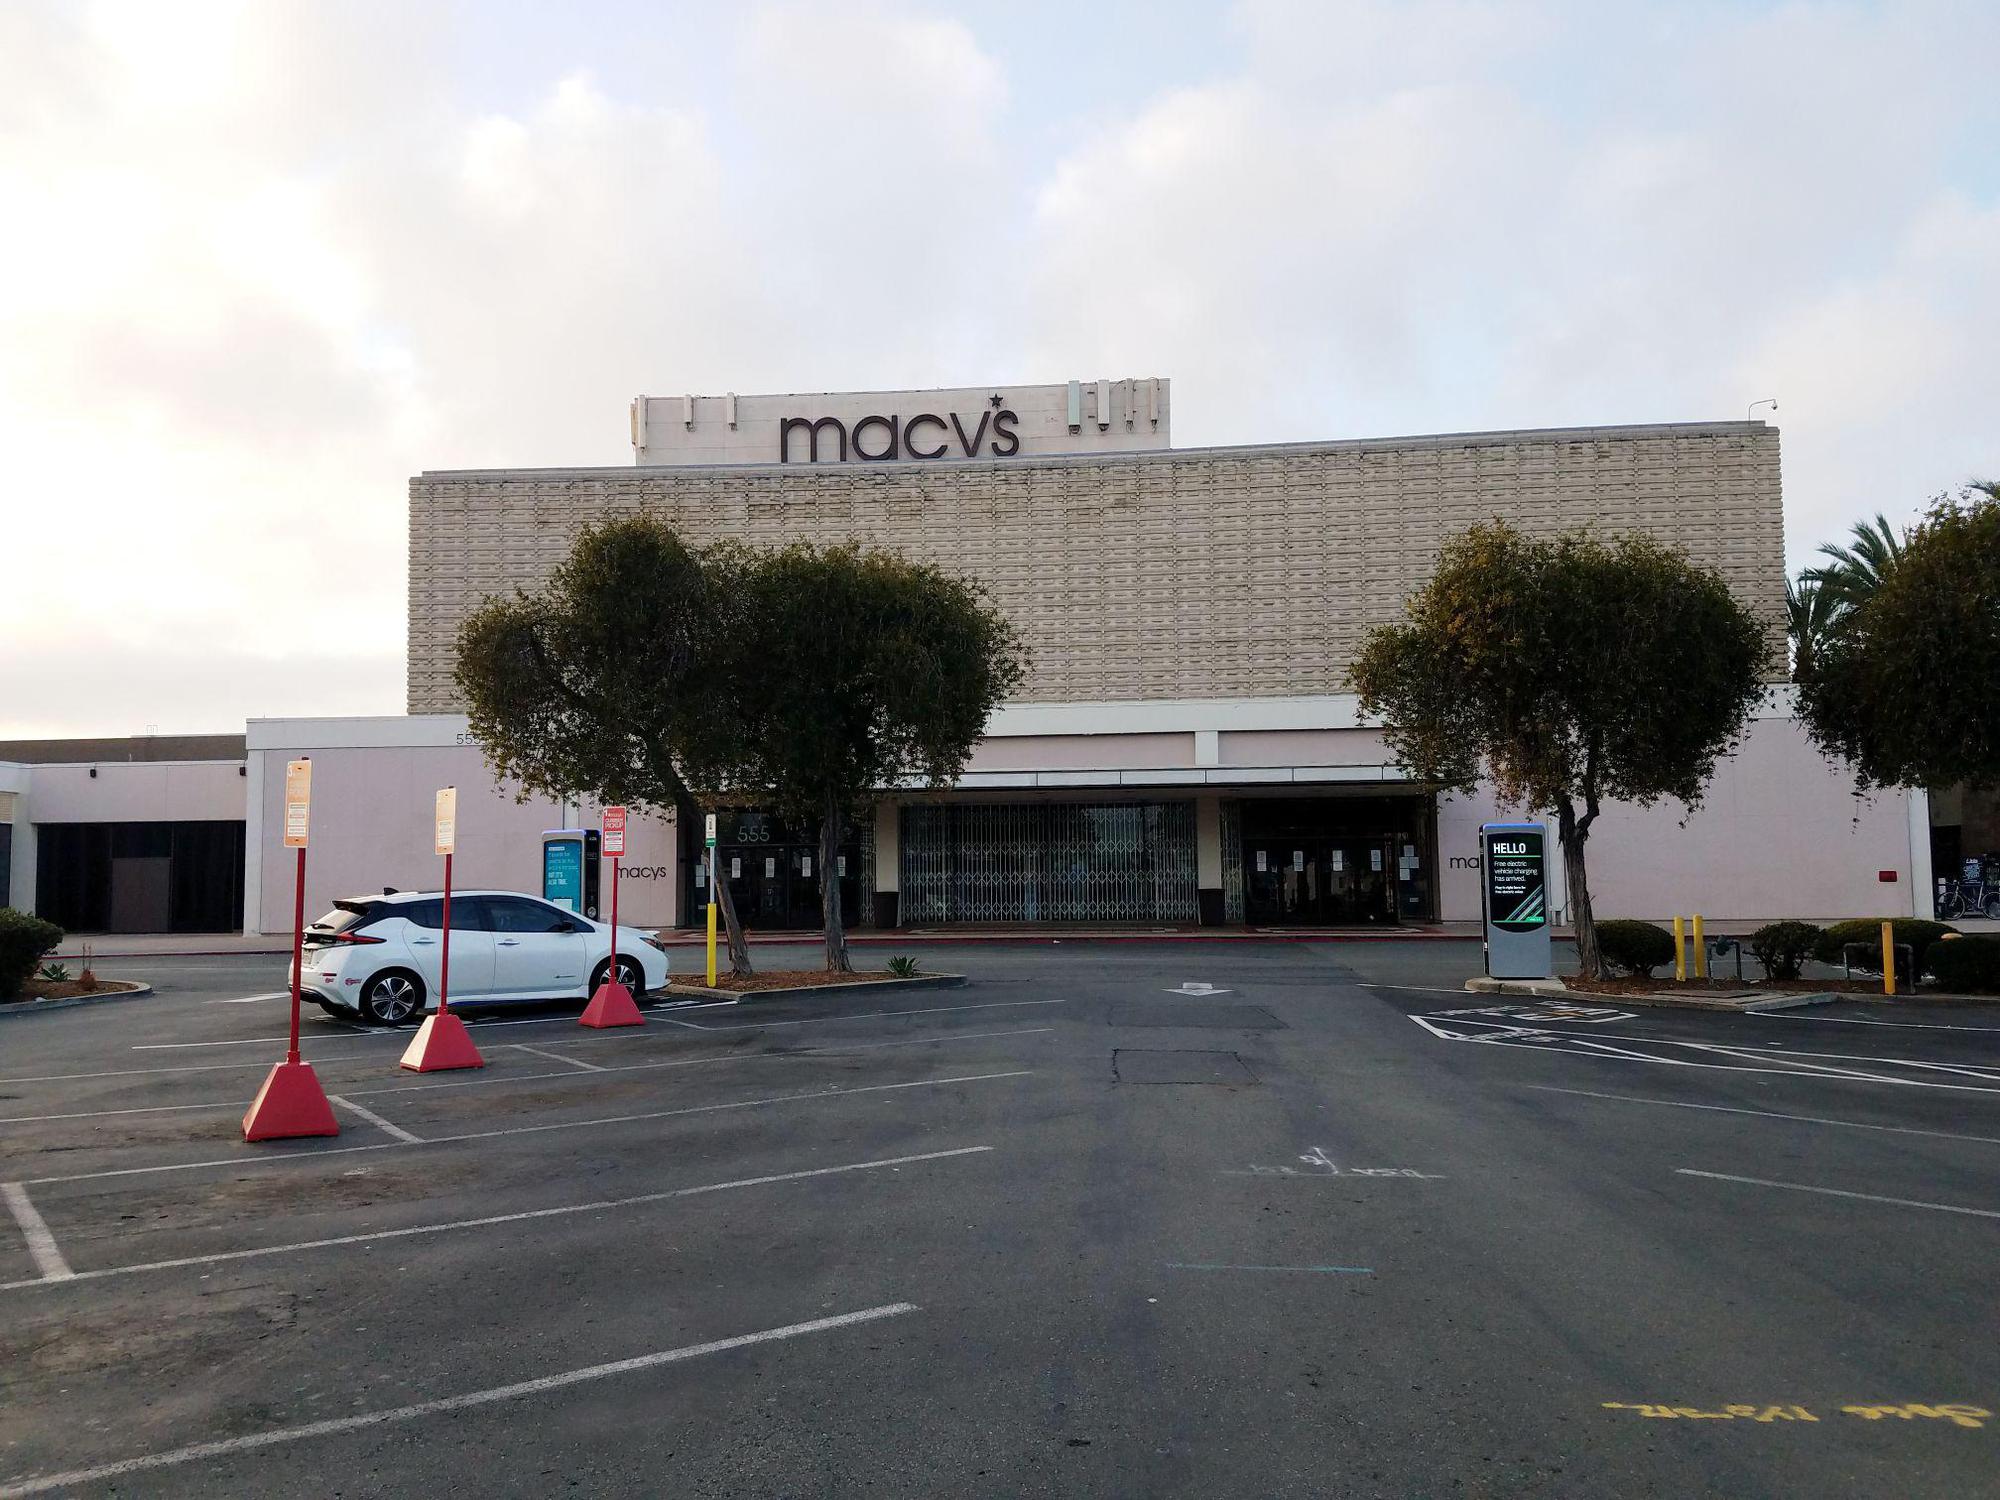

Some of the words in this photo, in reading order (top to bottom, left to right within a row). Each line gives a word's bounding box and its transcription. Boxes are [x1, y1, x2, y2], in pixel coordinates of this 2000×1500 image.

[737, 825, 770, 842] 555
[1493, 842, 1527, 854] HELLO
[1514, 868, 1538, 876] charging
